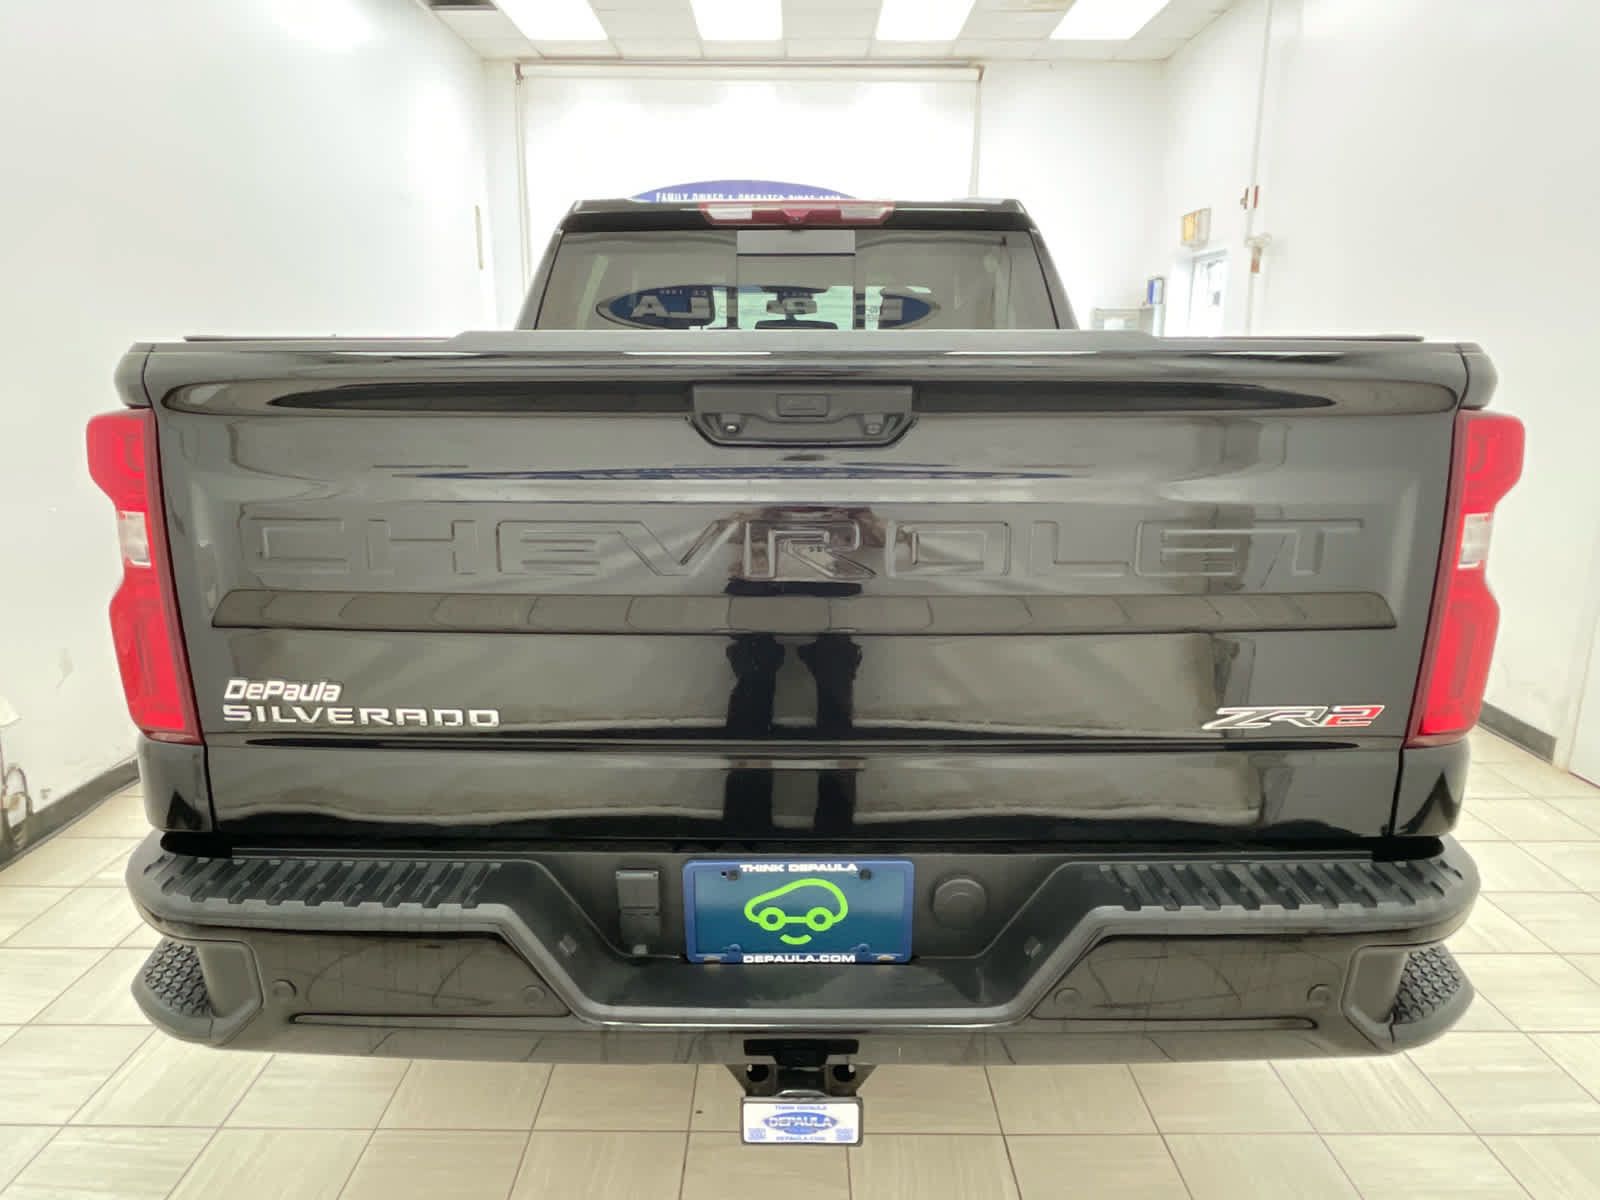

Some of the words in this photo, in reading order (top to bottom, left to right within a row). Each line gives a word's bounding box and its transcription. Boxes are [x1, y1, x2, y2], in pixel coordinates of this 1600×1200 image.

[655, 192, 689, 202] FAMILY
[240, 518, 1364, 577] CHEVROLET
[224, 679, 342, 701] DePaula
[223, 704, 500, 727] SILVERADO
[1201, 704, 1386, 730] ZR2
[739, 863, 784, 873] THINK
[788, 863, 858, 873] DEPAULA
[743, 953, 856, 963] DEPAULA.COM
[768, 1115, 833, 1128] DEPAULA
